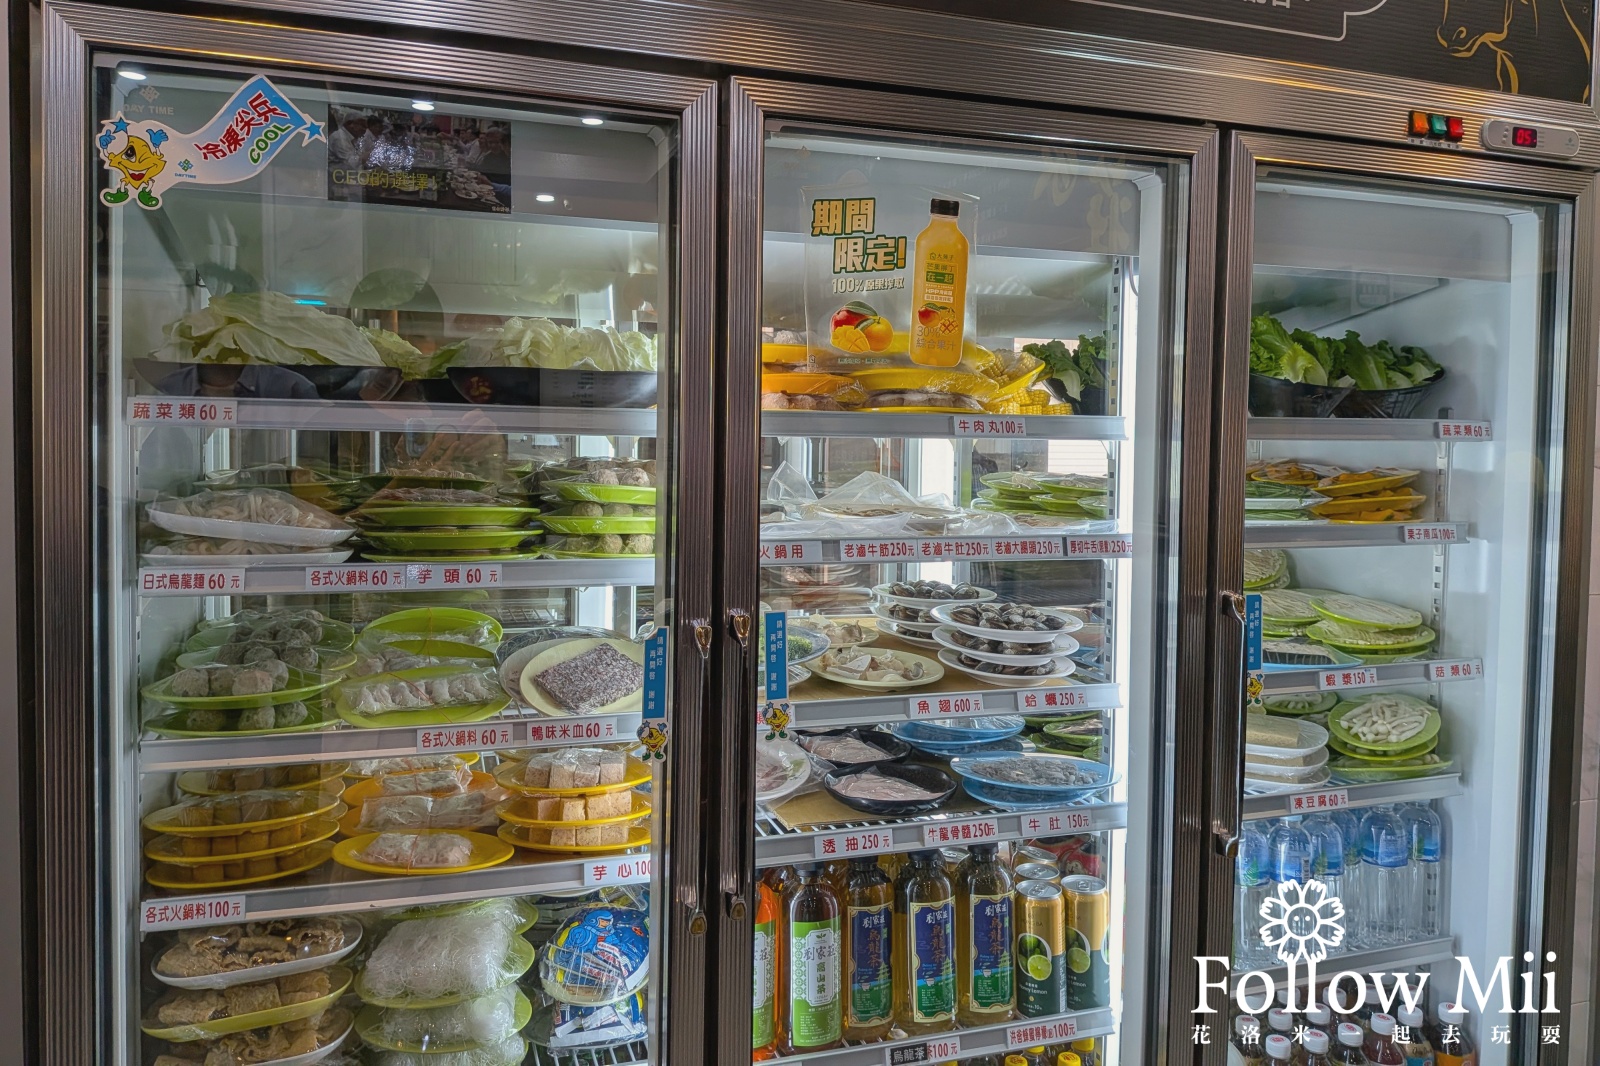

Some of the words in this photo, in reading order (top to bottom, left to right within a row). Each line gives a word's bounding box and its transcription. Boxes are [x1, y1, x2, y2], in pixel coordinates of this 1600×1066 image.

[148, 106, 174, 116] TIME
[194, 90, 290, 161] 冷凍尖兵
[249, 123, 294, 165] COOL
[811, 198, 876, 236] 期間
[926, 272, 954, 284] 在一起
